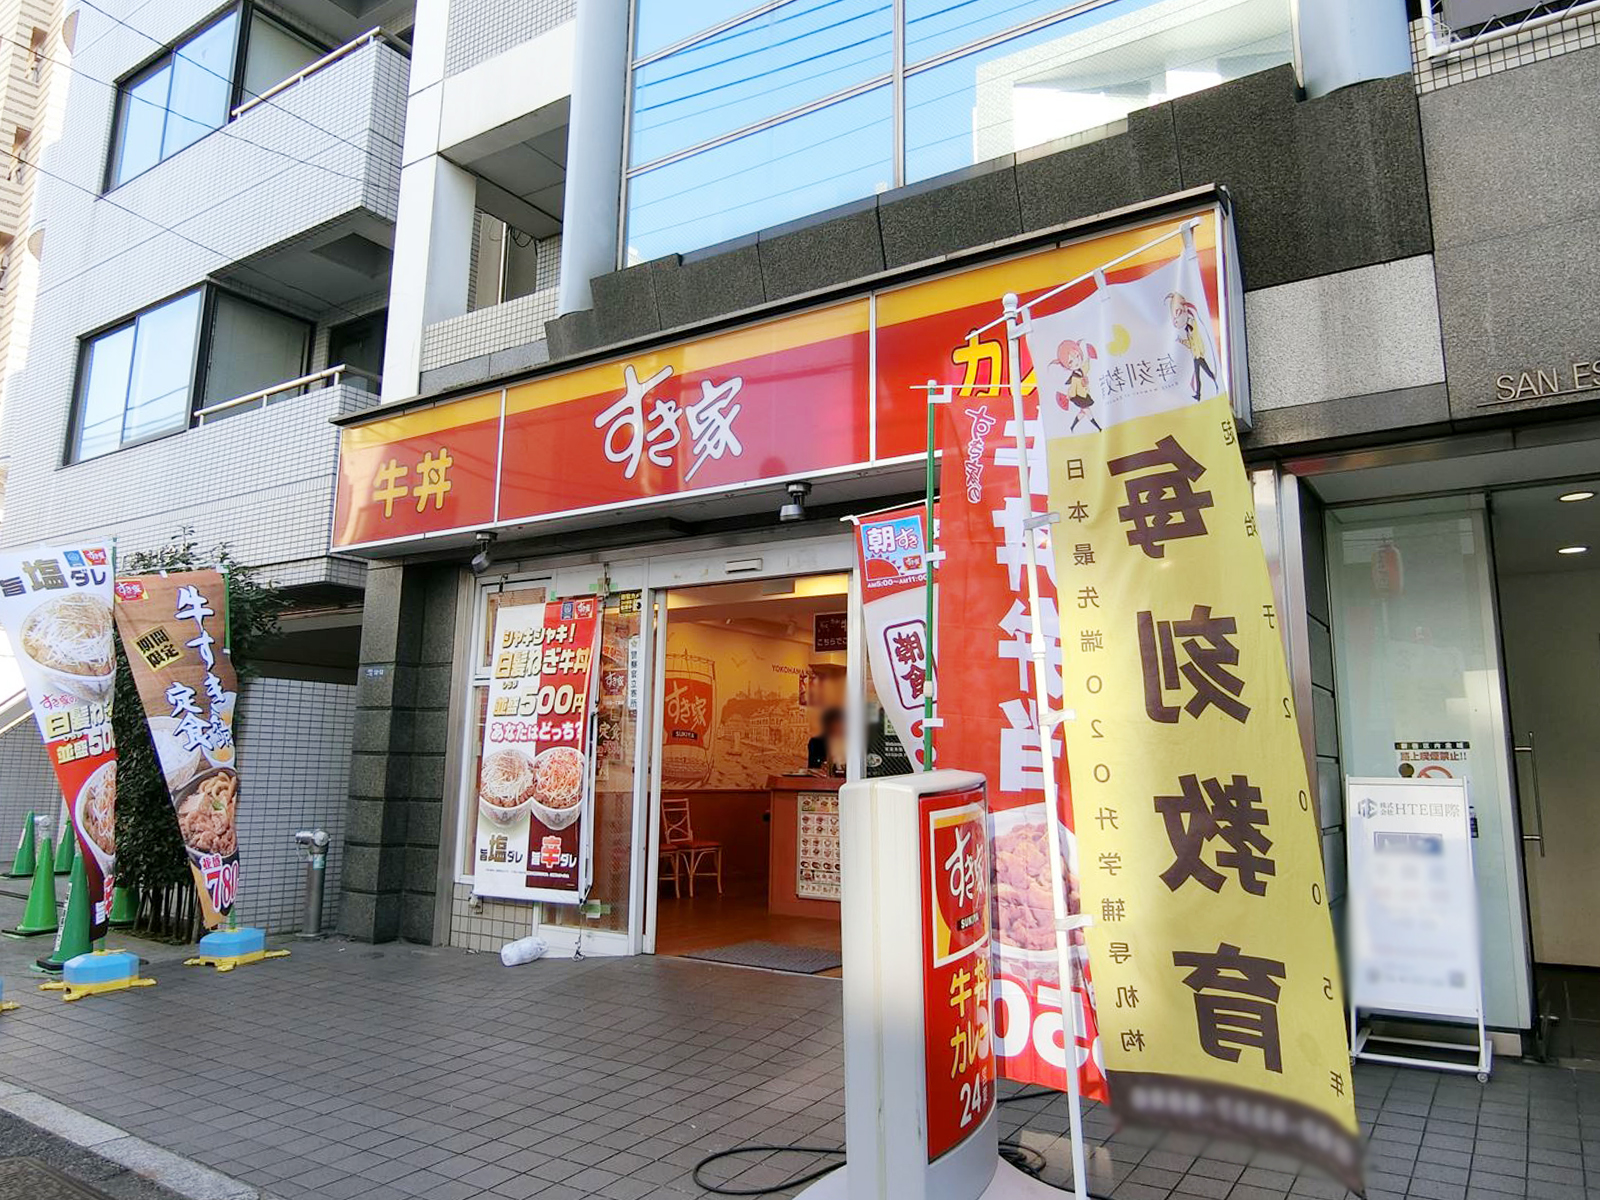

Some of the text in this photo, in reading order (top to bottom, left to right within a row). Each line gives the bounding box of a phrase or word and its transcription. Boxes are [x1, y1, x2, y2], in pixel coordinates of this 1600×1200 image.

[1496, 367, 1559, 400] SAN
[594, 364, 743, 482] すき家
[373, 446, 453, 519] 牛丼
[866, 524, 919, 554] 朝すき
[136, 628, 170, 654] 期間
[146, 644, 180, 669] 限定
[494, 646, 591, 679] 白髪ねぎ牛丼
[165, 681, 217, 751] 定食
[665, 680, 707, 731] すき家
[480, 834, 523, 863] 旨塩ダレ
[531, 836, 577, 868] 旨辛ダレ
[944, 826, 986, 909] すき家
[950, 954, 988, 1019] 牛丼
[950, 1020, 990, 1080] カレー
